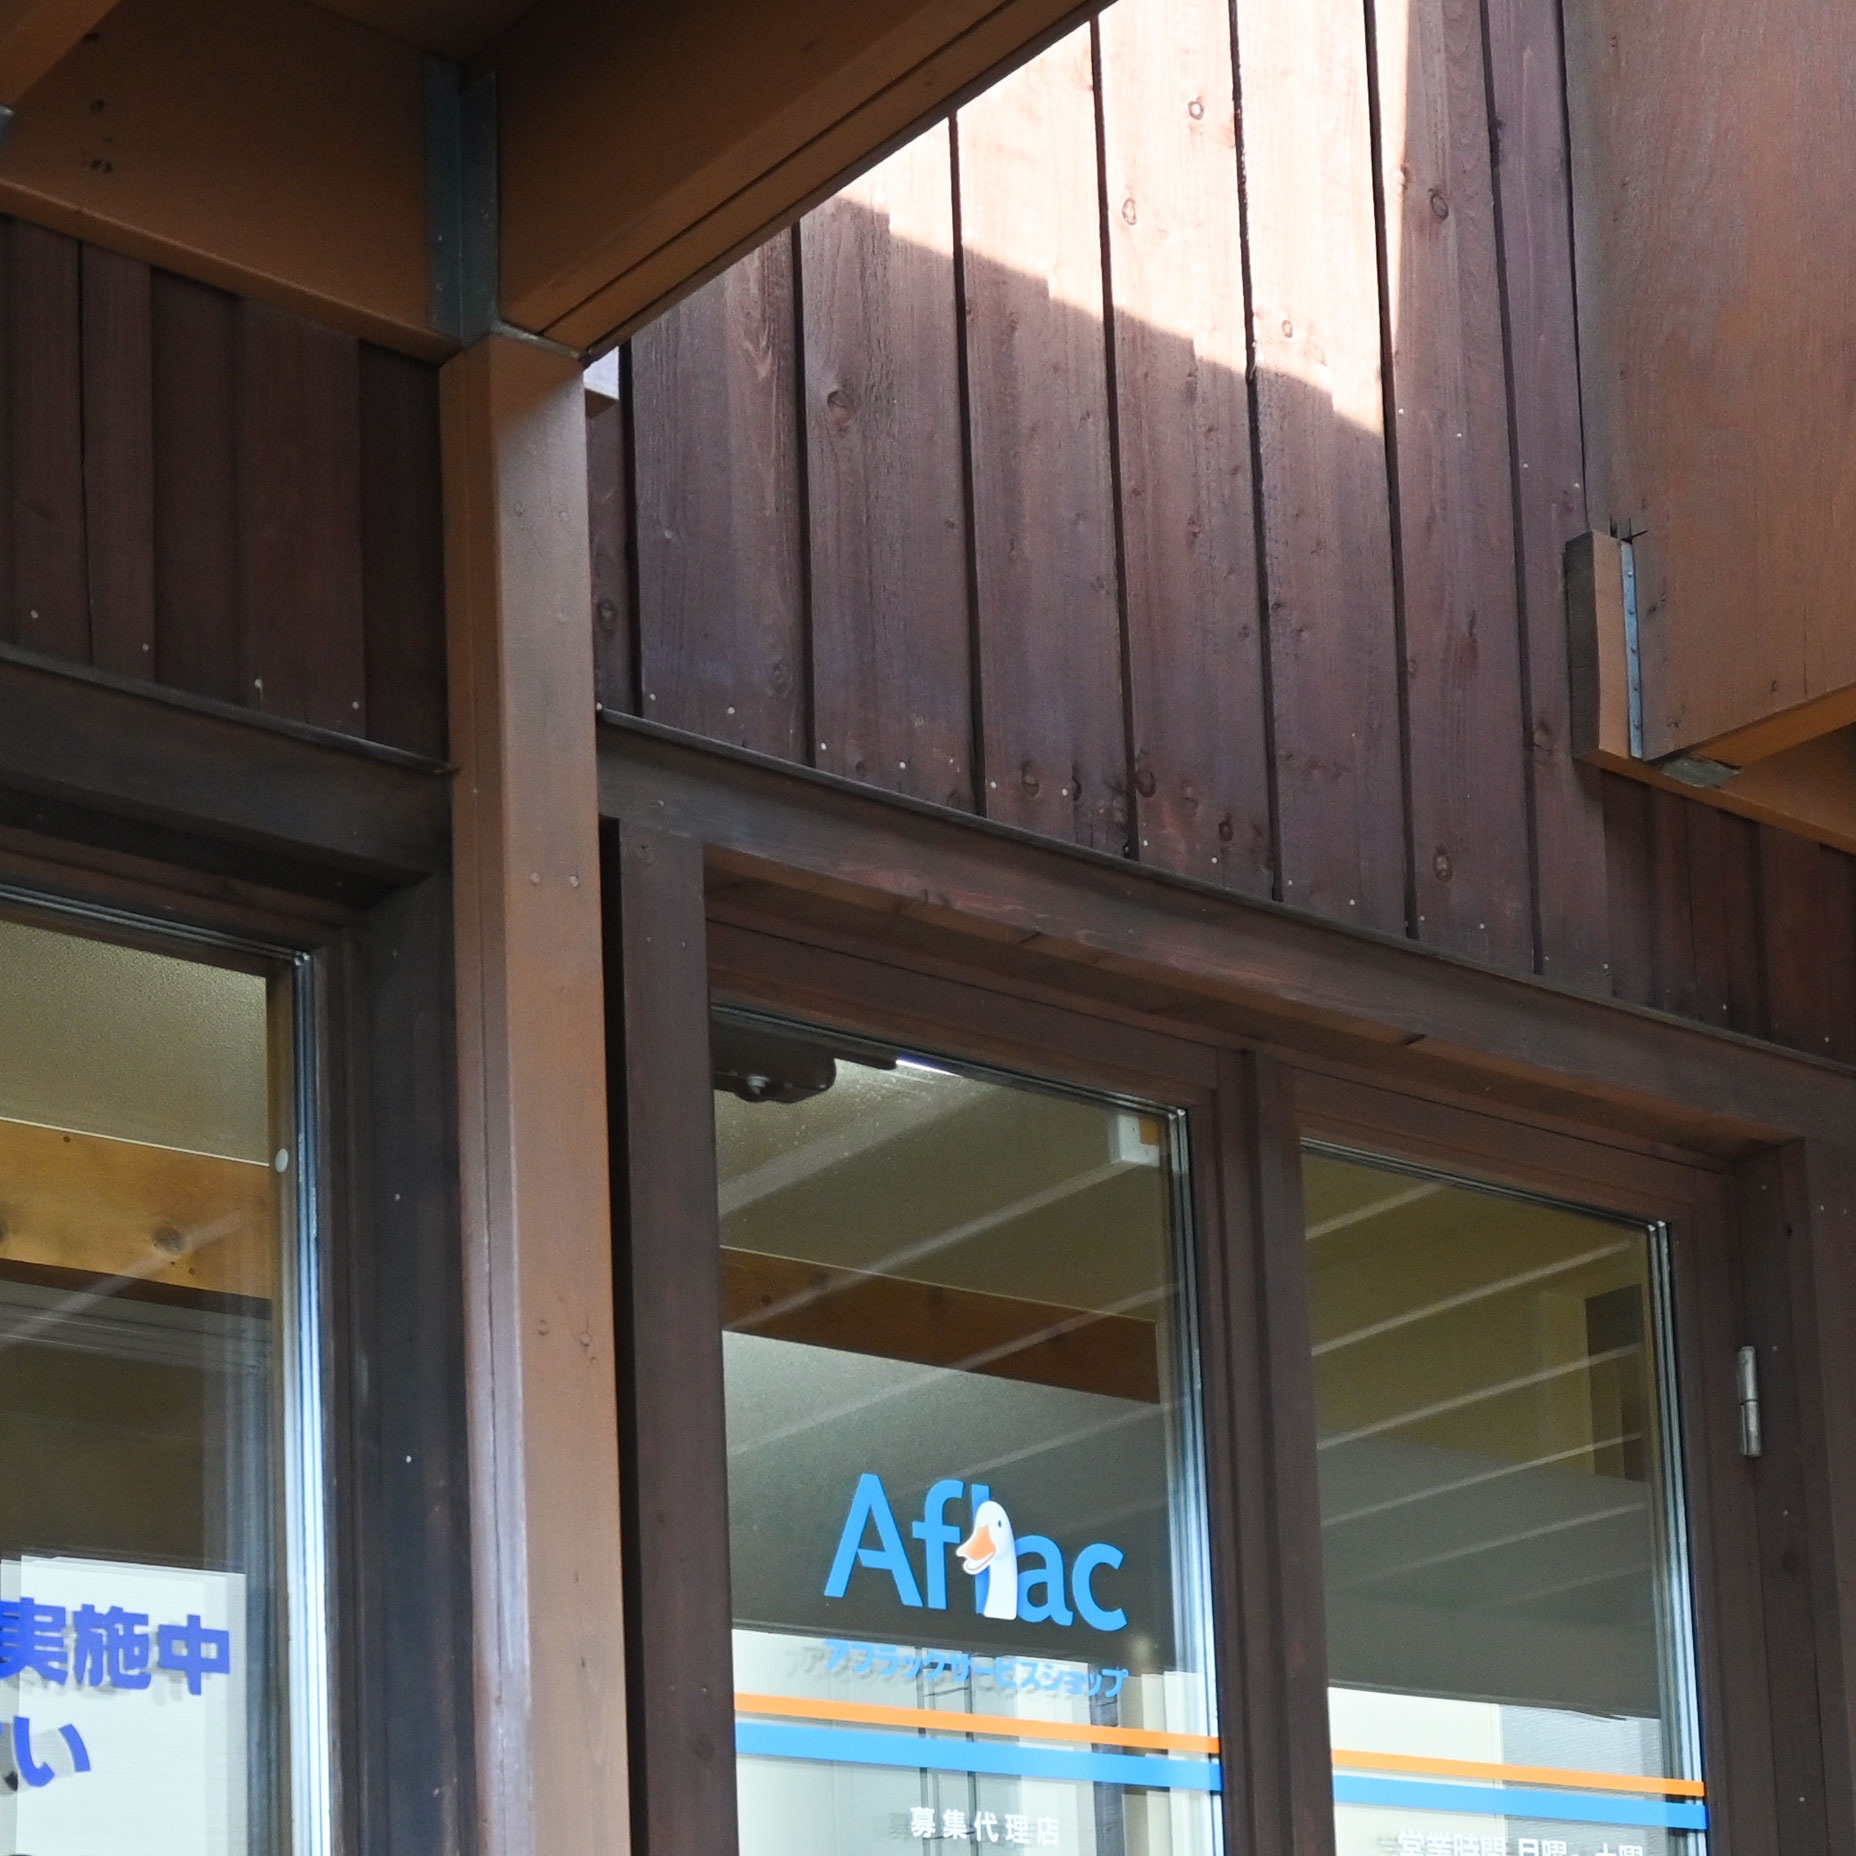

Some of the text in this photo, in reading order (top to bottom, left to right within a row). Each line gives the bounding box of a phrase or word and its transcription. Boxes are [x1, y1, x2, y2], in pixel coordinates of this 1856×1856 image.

[824, 1638, 1129, 1698] アフラックサービスショップ
[910, 1806, 1060, 1846] 募集代理店
